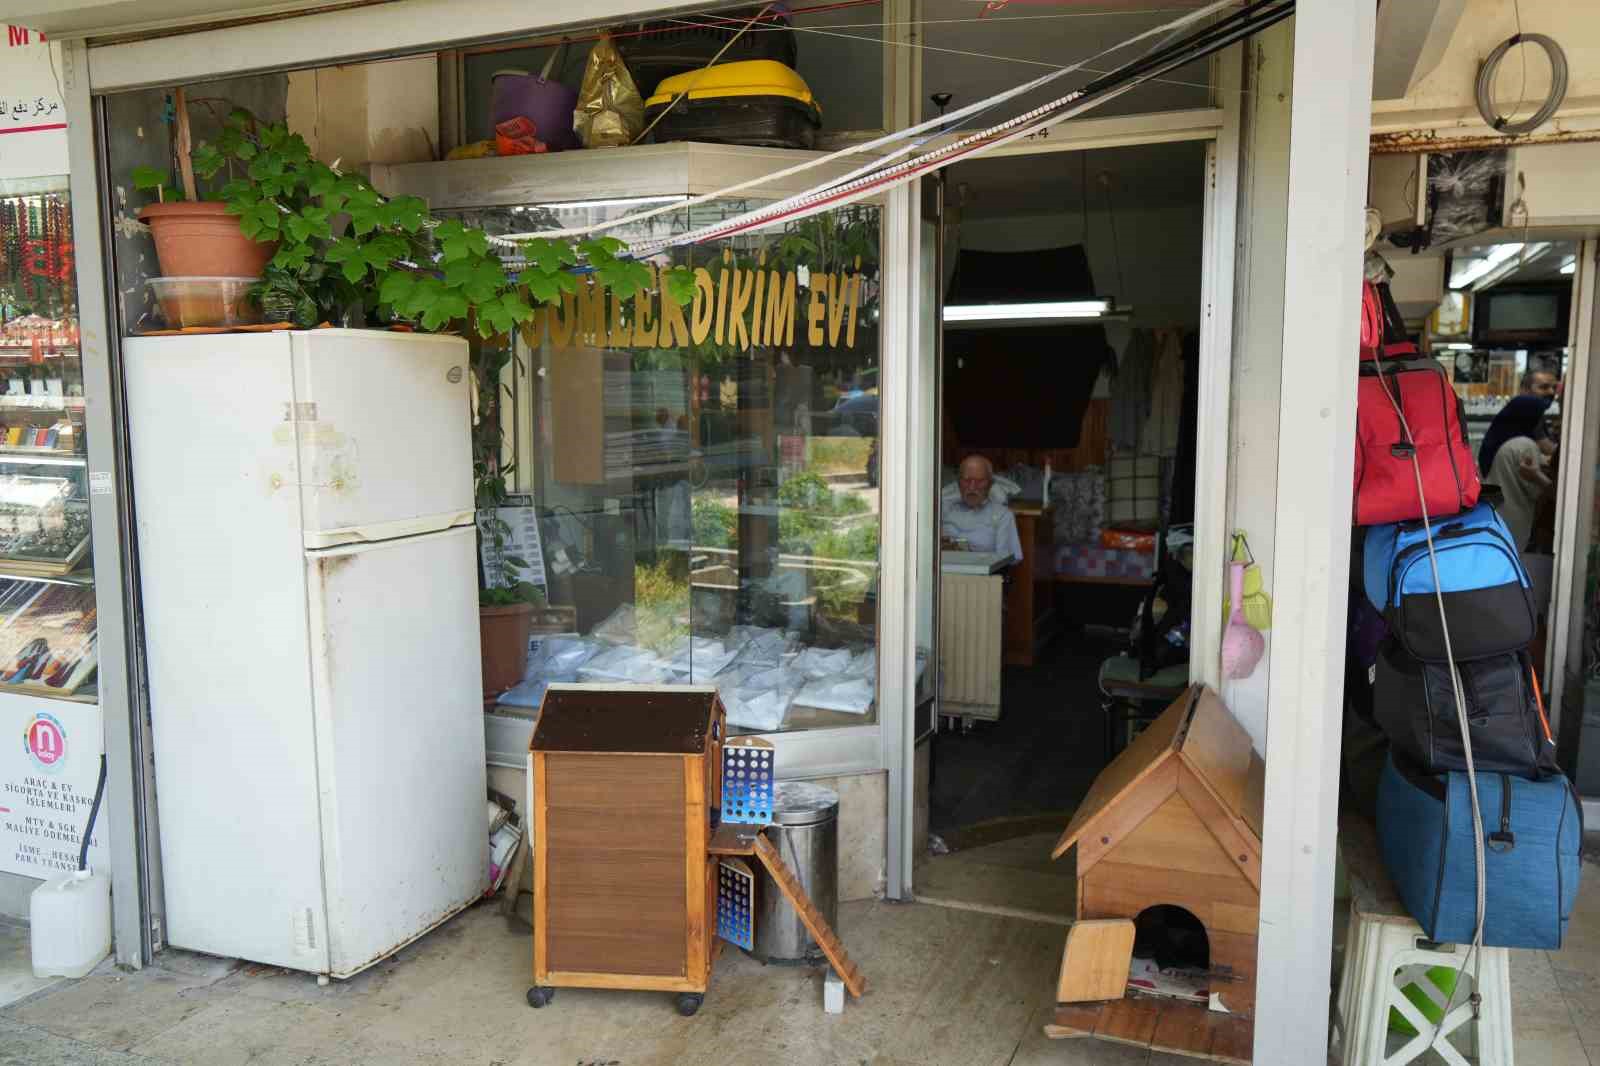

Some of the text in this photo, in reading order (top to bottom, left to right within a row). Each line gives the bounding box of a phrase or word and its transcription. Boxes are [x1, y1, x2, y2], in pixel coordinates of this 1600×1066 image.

[691, 247, 795, 352] DİKİM
[807, 255, 861, 350] EVİ
[24, 816, 44, 826] MTV
